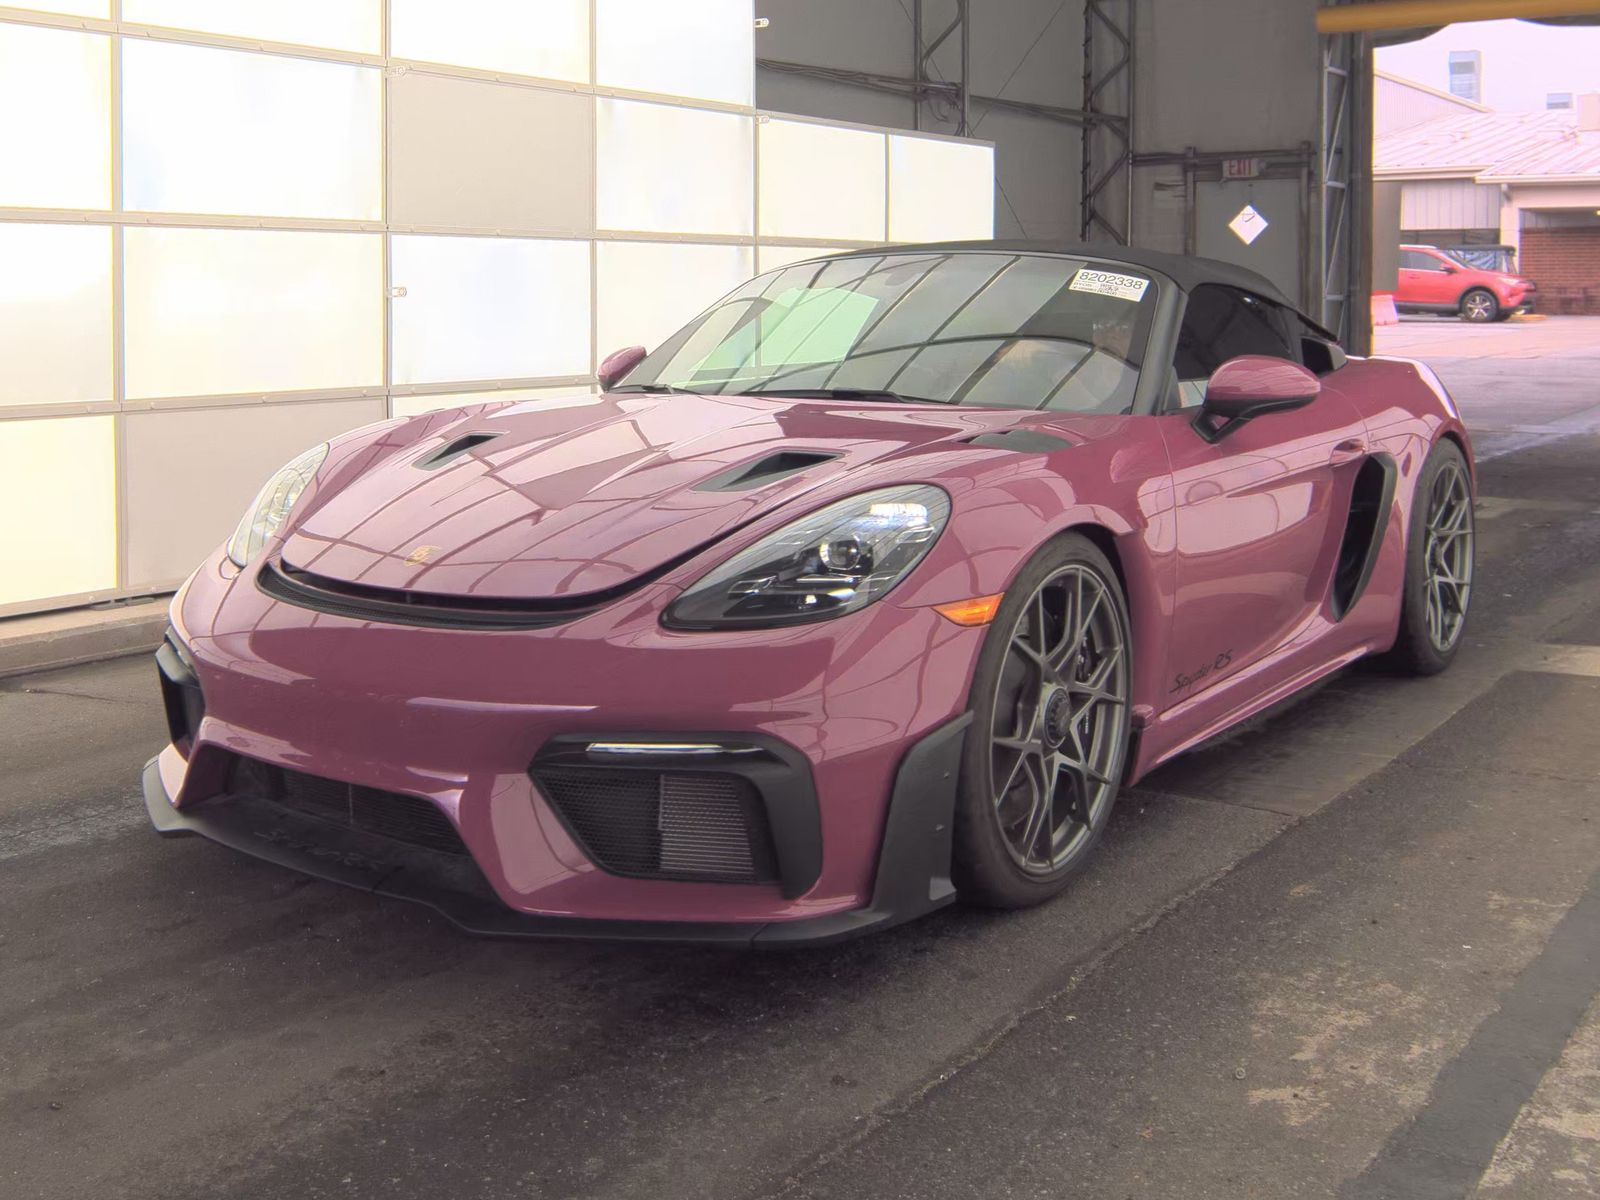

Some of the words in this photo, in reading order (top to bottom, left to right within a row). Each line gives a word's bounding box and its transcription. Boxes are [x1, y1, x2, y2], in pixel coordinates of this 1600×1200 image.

[1228, 159, 1252, 177] EXIT
[1079, 271, 1144, 290] 8202338
[1213, 648, 1233, 670] RS
